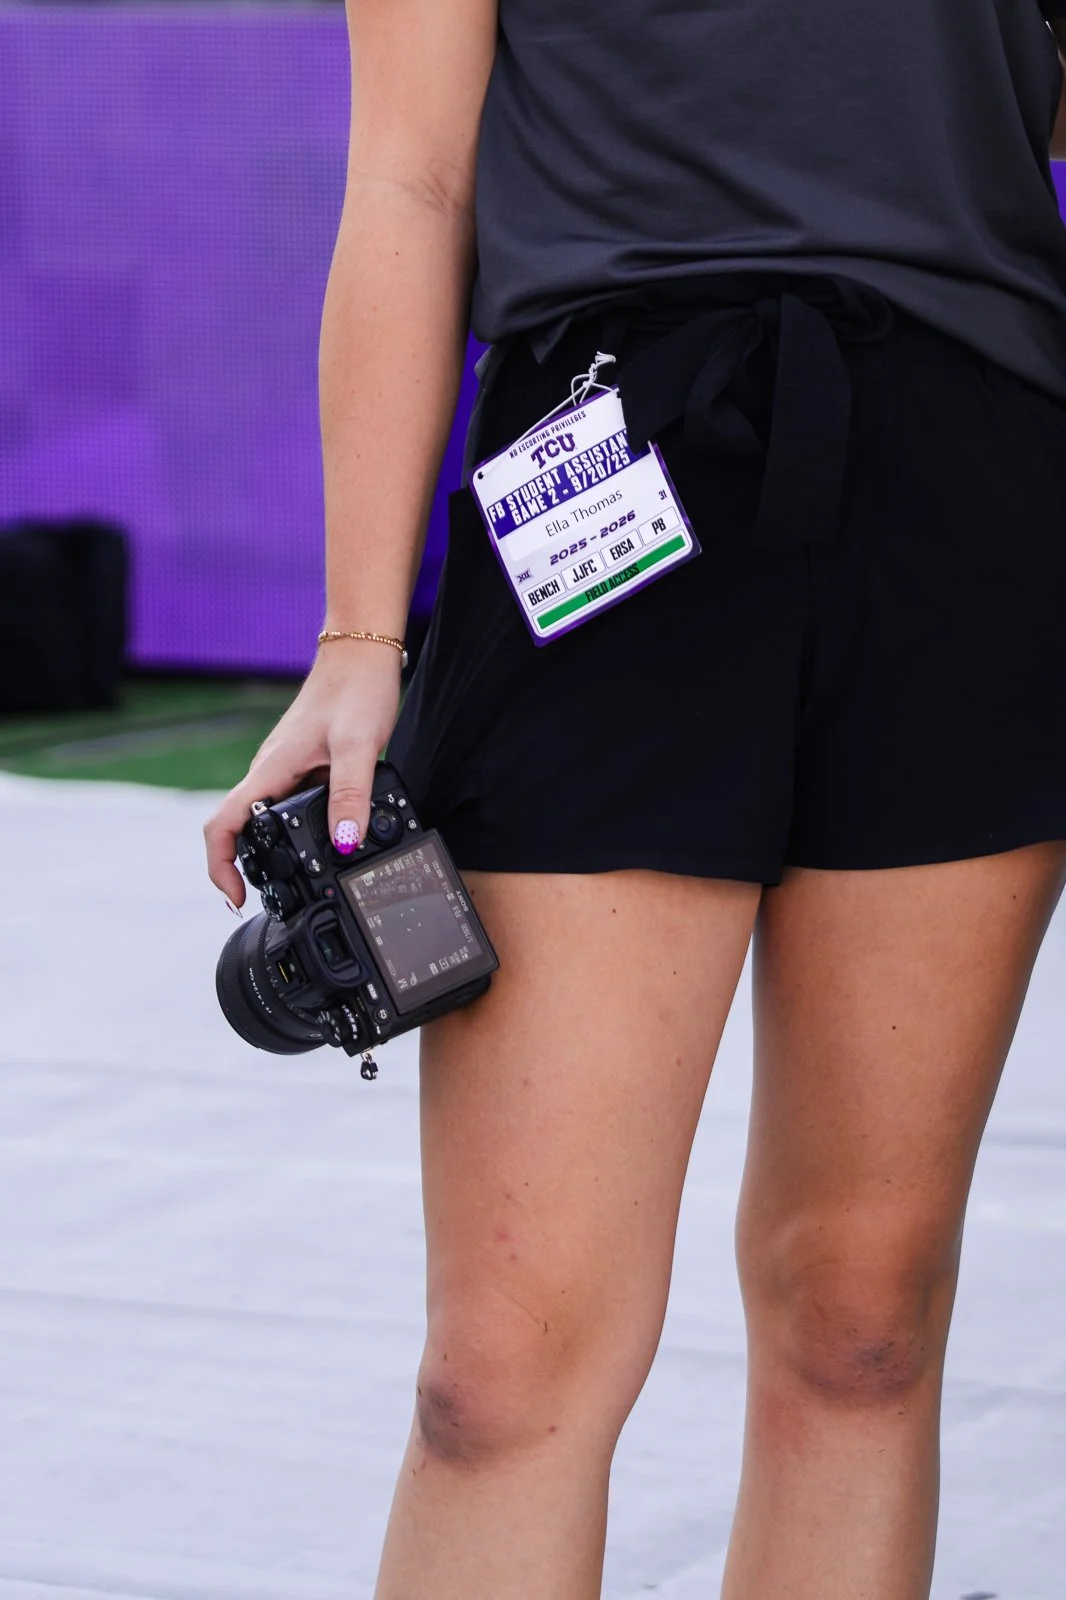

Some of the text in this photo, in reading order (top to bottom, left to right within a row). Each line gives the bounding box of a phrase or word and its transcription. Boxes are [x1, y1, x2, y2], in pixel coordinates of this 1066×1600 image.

[509, 410, 587, 459] NO ESCORTING PRIVILEGES
[530, 433, 576, 470] TCU
[487, 430, 628, 523] FB STUDENT ASSISTAN
[511, 494, 547, 526] GAME
[548, 488, 560, 505] 2
[570, 450, 631, 492] 9/20/25
[545, 490, 623, 537] Ella Thomas
[652, 517, 667, 535] PB
[550, 538, 588, 566] 2025
[600, 510, 636, 539] 2026
[609, 538, 635, 561] ERSA
[572, 558, 598, 583] JJFC
[584, 562, 641, 603] FIELD ACCESS
[528, 579, 561, 606] BENCH
[456, 890, 469, 912] SONY
